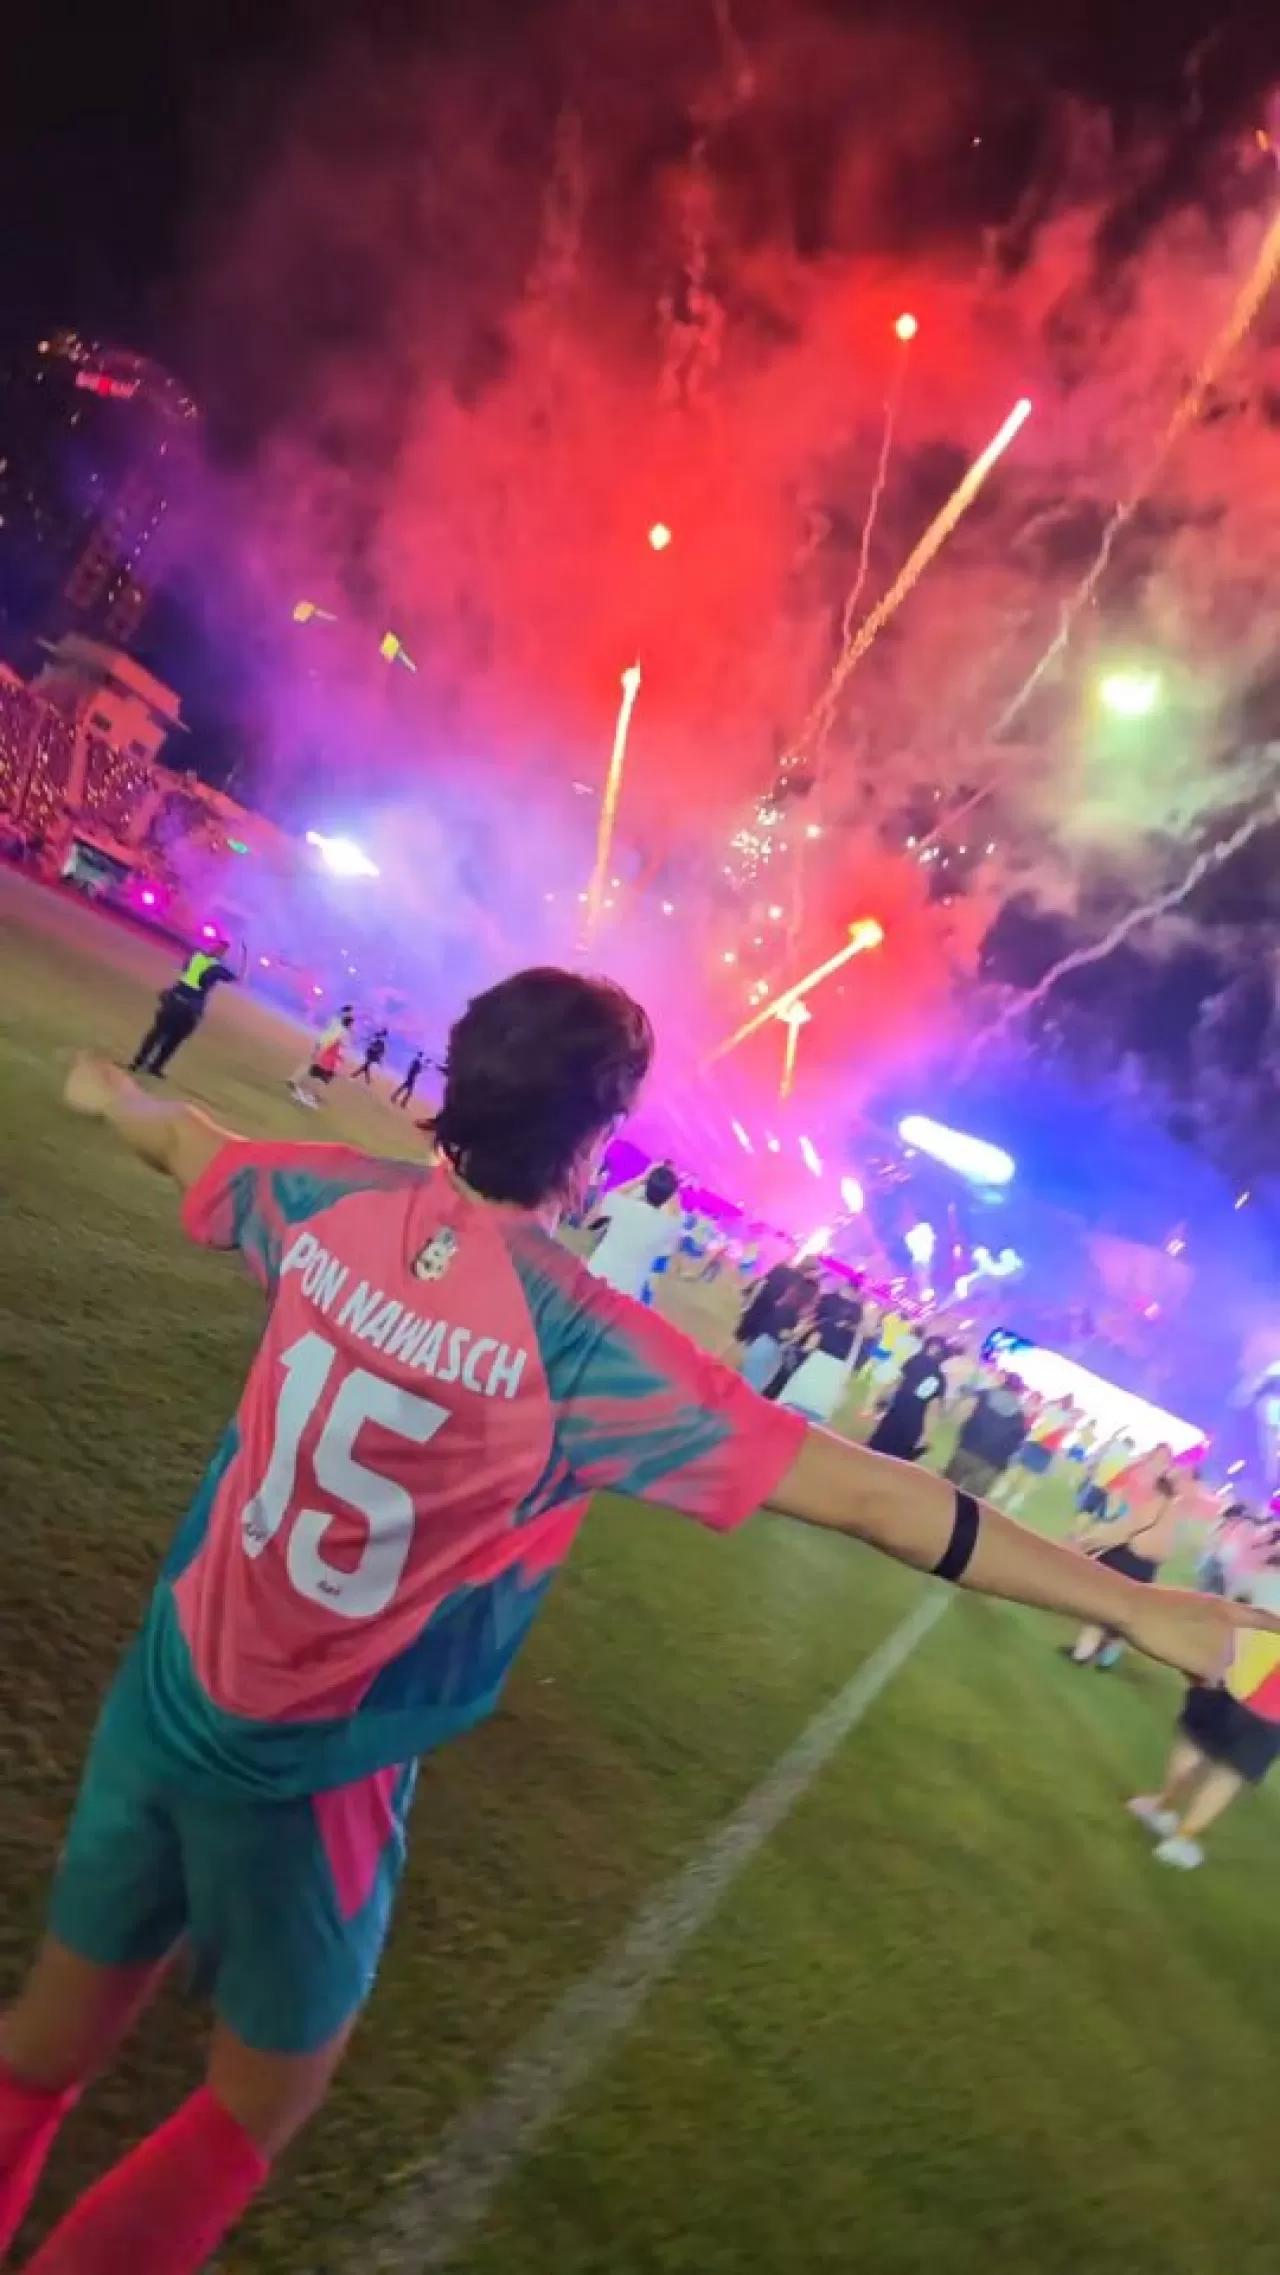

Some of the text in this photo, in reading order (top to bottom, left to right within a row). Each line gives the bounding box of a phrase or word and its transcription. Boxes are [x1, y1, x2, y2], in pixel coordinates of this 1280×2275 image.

[280, 1232, 526, 1399] PON NAWASCH
[242, 1331, 452, 1619] 15
